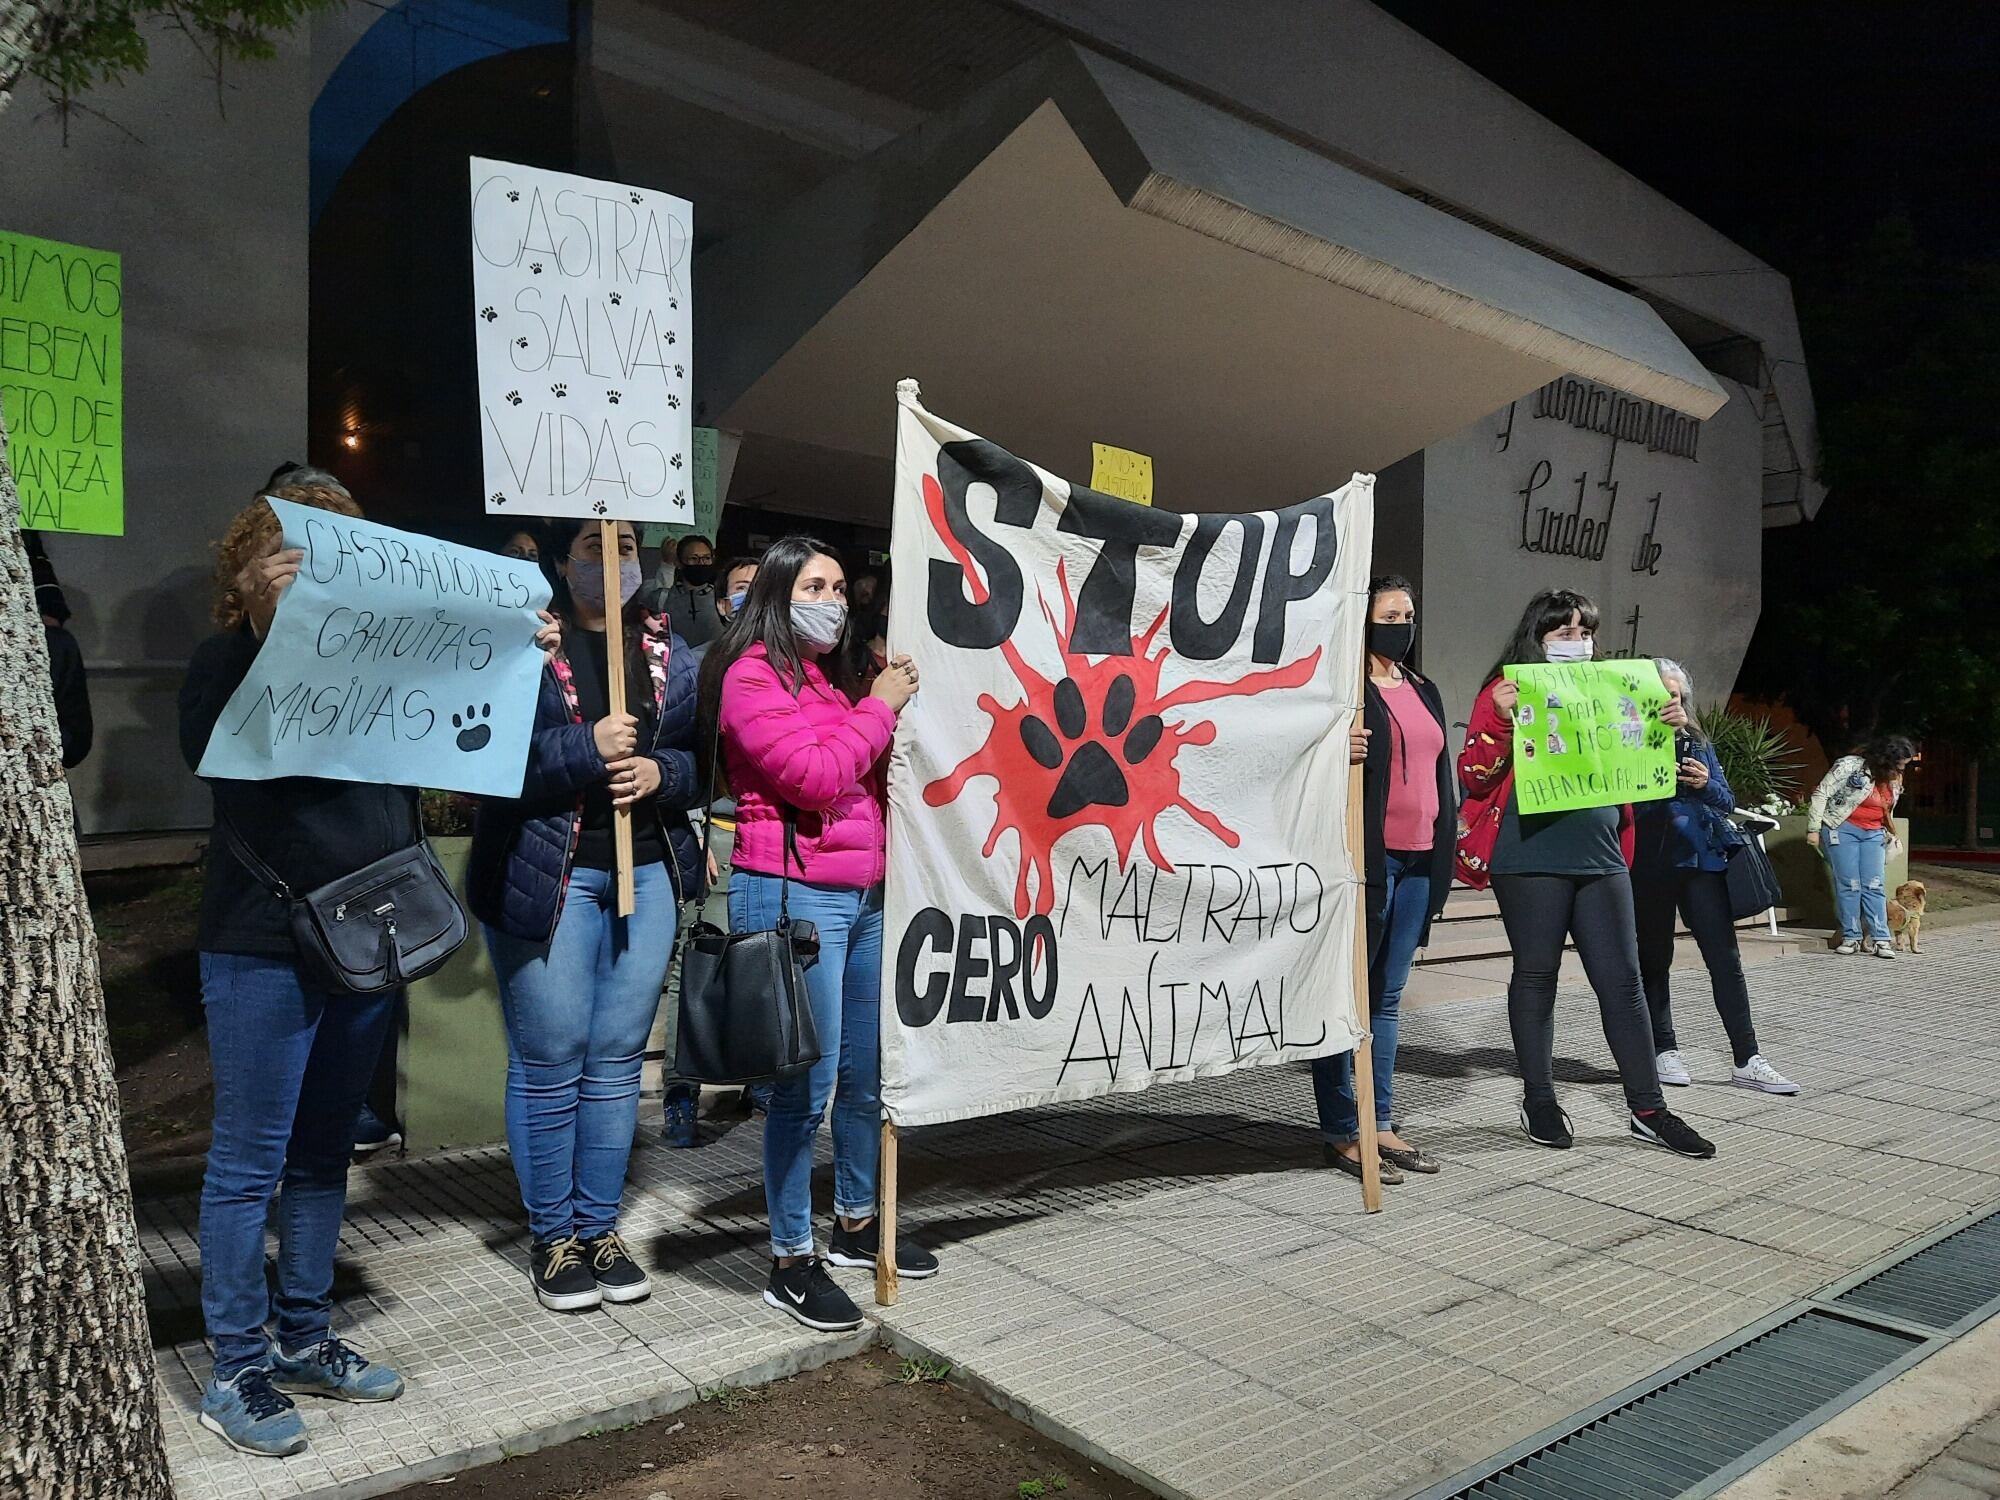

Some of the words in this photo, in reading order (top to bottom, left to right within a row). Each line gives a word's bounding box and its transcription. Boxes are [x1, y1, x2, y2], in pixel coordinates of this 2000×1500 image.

[0, 241, 121, 317] IMOS
[473, 175, 687, 297] CASTRAR
[509, 286, 671, 386] SALVA
[72, 396, 114, 447] DE
[484, 405, 667, 501] VIDAS
[925, 438, 1338, 665] STOP
[1516, 459, 1619, 562] Ciudad
[1632, 491, 1662, 576] de
[305, 518, 530, 609] CASTRACIONES
[316, 606, 493, 671] GRATUITAS
[231, 675, 435, 746] MASIVAS
[1576, 724, 1613, 755] NO
[1060, 855, 1326, 944] MALTRATO
[895, 906, 1059, 1028] CERO
